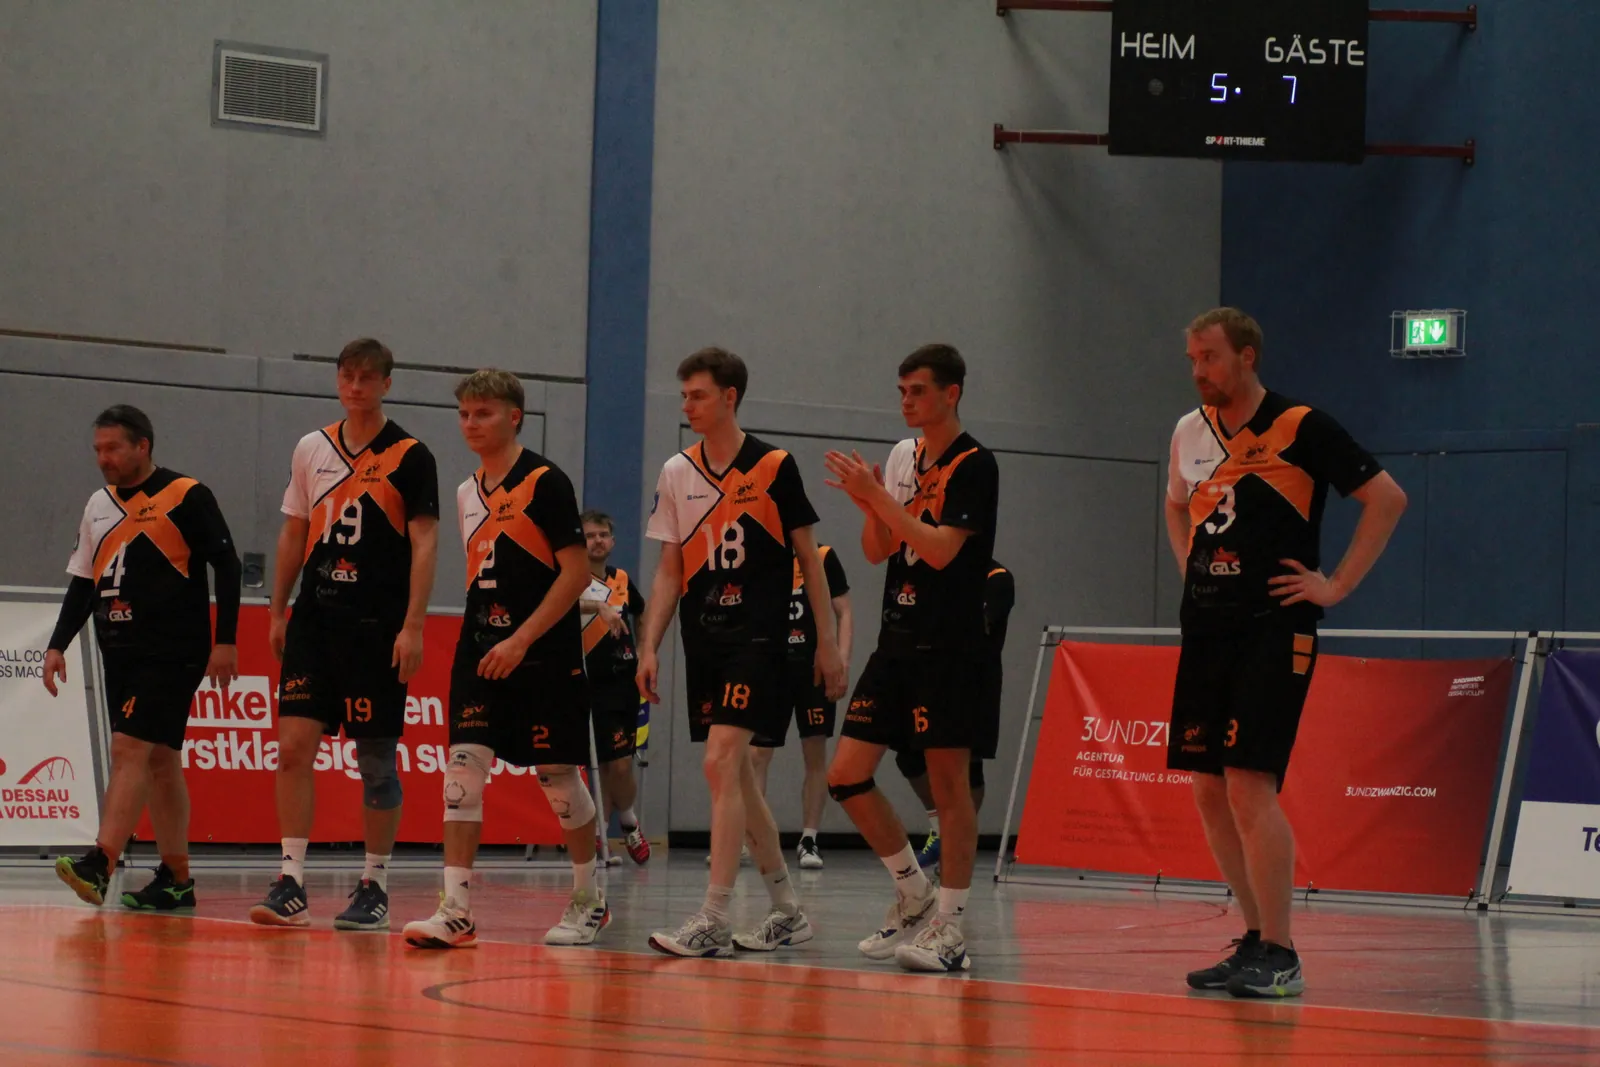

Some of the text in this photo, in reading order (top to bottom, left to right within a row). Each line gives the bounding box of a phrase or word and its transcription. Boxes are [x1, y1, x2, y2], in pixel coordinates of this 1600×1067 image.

[1120, 32, 1195, 60] HEIM
[1265, 35, 1365, 66] GÄSTE
[1282, 75, 1297, 103] 7
[321, 496, 363, 545] 19
[1205, 484, 1237, 535] 3
[702, 520, 746, 571] 18
[102, 541, 127, 588] 4
[331, 569, 358, 583] GAS
[1210, 561, 1241, 576] GAS
[719, 593, 743, 606] GAS
[788, 588, 805, 620] 5
[108, 608, 133, 622] GAS
[15, 665, 60, 678] MAC
[121, 696, 136, 719] 4
[190, 684, 267, 721] nke
[404, 695, 444, 726] en
[722, 682, 751, 710] 18
[344, 697, 372, 722] 19
[807, 707, 825, 726] 15
[531, 725, 551, 749] 2
[1223, 717, 1239, 748] 3
[1076, 751, 1125, 764] AGENTUR
[1073, 764, 1194, 785] FÜR GESTALTUNG & KOMM
[2, 788, 70, 802] DESSAU
[1345, 785, 1437, 798] 3UNDZWANZIG.COM
